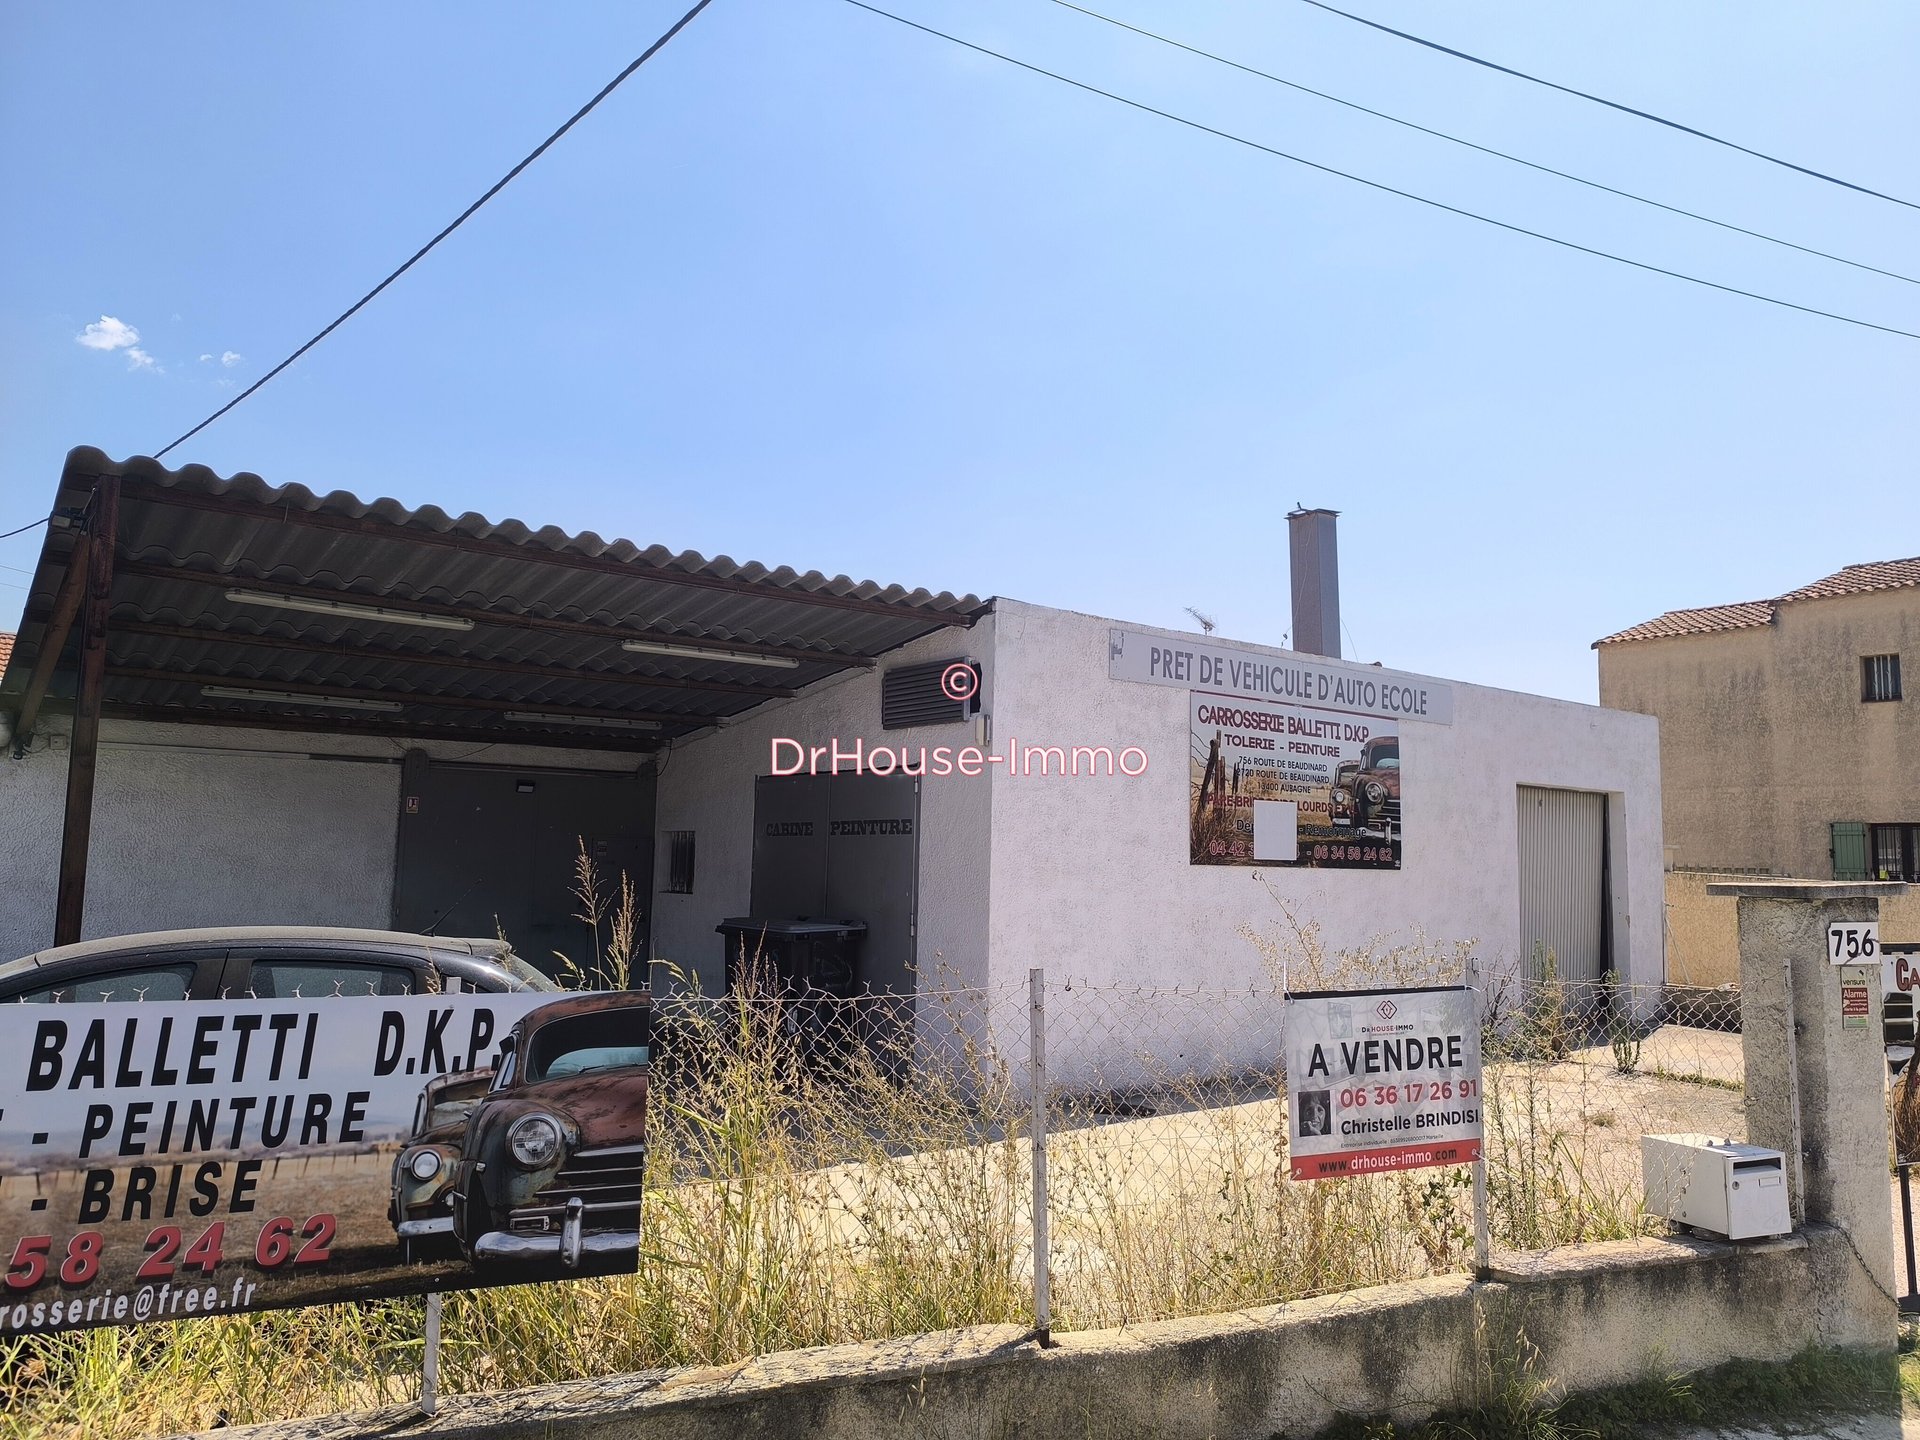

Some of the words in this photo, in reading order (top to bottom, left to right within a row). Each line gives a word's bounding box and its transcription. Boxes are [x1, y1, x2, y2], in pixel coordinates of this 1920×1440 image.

[1150, 647, 1193, 681] PRET
[1199, 654, 1223, 686] DE
[1229, 659, 1312, 699] VEHICULE
[1318, 674, 1376, 708] D'AUTO
[1381, 684, 1427, 715] ECOLE
[1198, 704, 1285, 734] CARROSSERIE
[1287, 716, 1341, 741] BALLETTI
[1224, 734, 1275, 751] TOLERIE
[1288, 741, 1340, 758] PEINTURE
[1253, 757, 1275, 768] ROUTE
[1277, 760, 1286, 768] DE
[1287, 761, 1328, 773] BEAUDINARD
[1255, 769, 1277, 779] ROUTE
[1279, 772, 1288, 781] DE
[1289, 773, 1330, 784] BEAUDINARD
[1280, 784, 1312, 794] AUBAGNE
[766, 822, 813, 837] CABINE
[830, 818, 912, 836] PEINTURE
[1210, 840, 1226, 856] 04
[1228, 840, 1245, 857] 42
[1313, 845, 1329, 860] 06
[1330, 845, 1345, 860] 34
[1363, 847, 1377, 861] 24
[1831, 929, 1874, 958] 756
[1843, 988, 1867, 998] Alarme
[26, 1013, 319, 1092] BALLETTI
[1308, 1043, 1329, 1077] A
[1341, 1035, 1463, 1074] VENDRE
[1340, 1087, 1367, 1108] 06
[1374, 1085, 1398, 1106] 36
[1404, 1083, 1423, 1103] 17
[1430, 1081, 1453, 1101] 26
[1459, 1079, 1477, 1098] 91
[78, 1090, 371, 1159] PEINTURE
[1341, 1115, 1411, 1136] Christelle
[1416, 1108, 1479, 1129] BRINDISI
[1318, 1148, 1457, 1173] www.drhouse-immo.com
[78, 1159, 262, 1224] BRISE
[5, 1230, 104, 1290] 58
[135, 1220, 226, 1278] 24
[255, 1212, 337, 1268] 62
